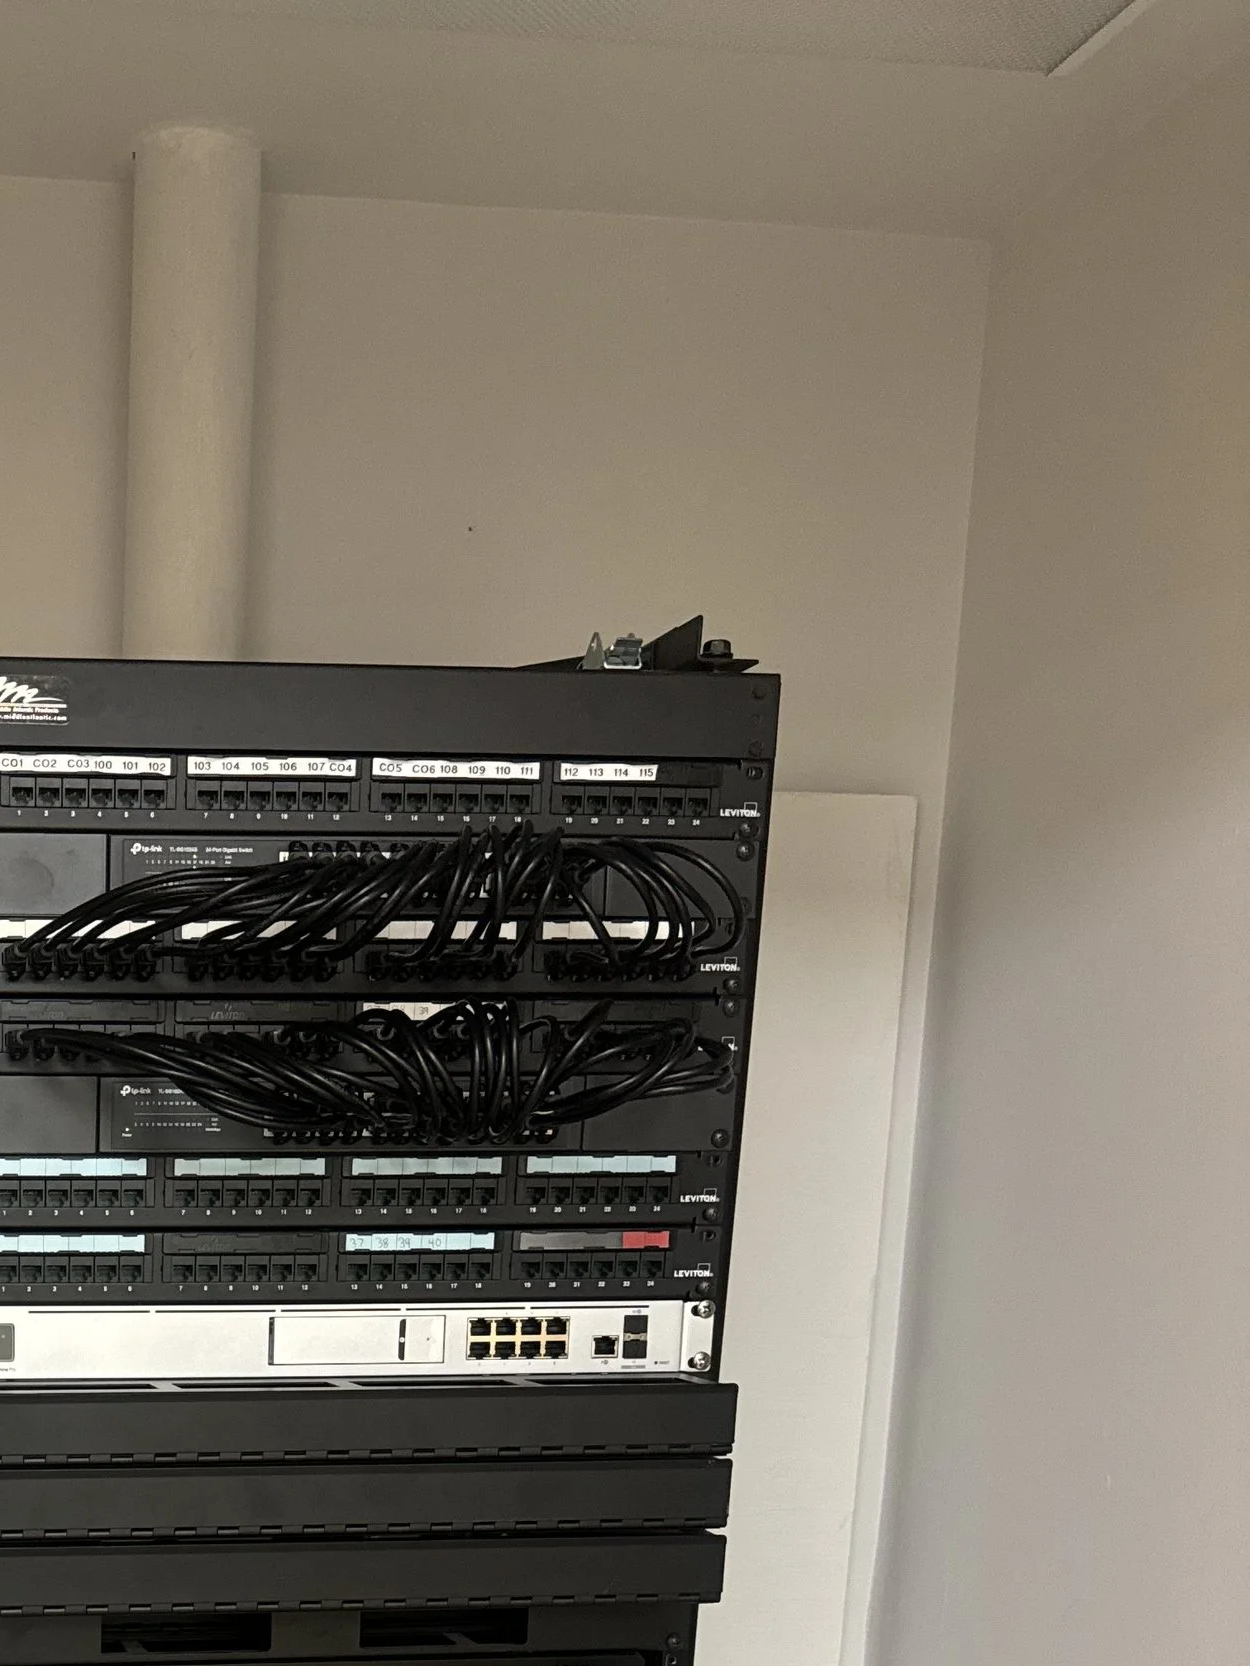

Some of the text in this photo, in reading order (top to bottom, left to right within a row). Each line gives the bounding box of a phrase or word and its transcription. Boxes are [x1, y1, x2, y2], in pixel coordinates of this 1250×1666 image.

[94, 760, 112, 770] 100
[123, 761, 138, 771] 101
[148, 762, 166, 771] 102
[194, 761, 211, 771] 103
[222, 762, 240, 771] 104
[251, 762, 269, 771] 105
[279, 762, 297, 771] 106
[308, 762, 326, 771] 107
[440, 765, 458, 774] 108
[468, 765, 486, 775] 109
[495, 766, 511, 775] 110
[520, 766, 533, 775] 111
[564, 767, 654, 777] 112 113 114 115
[720, 808, 758, 817] LEVITON
[141, 845, 163, 854] tp-link
[701, 963, 737, 972] LEVITON
[131, 1087, 151, 1095] tp-link
[680, 1194, 717, 1203] LEVITON
[378, 1237, 389, 1247] 38
[398, 1237, 411, 1247] 39
[428, 1236, 442, 1247] 40
[674, 1269, 710, 1278] LEVITON
